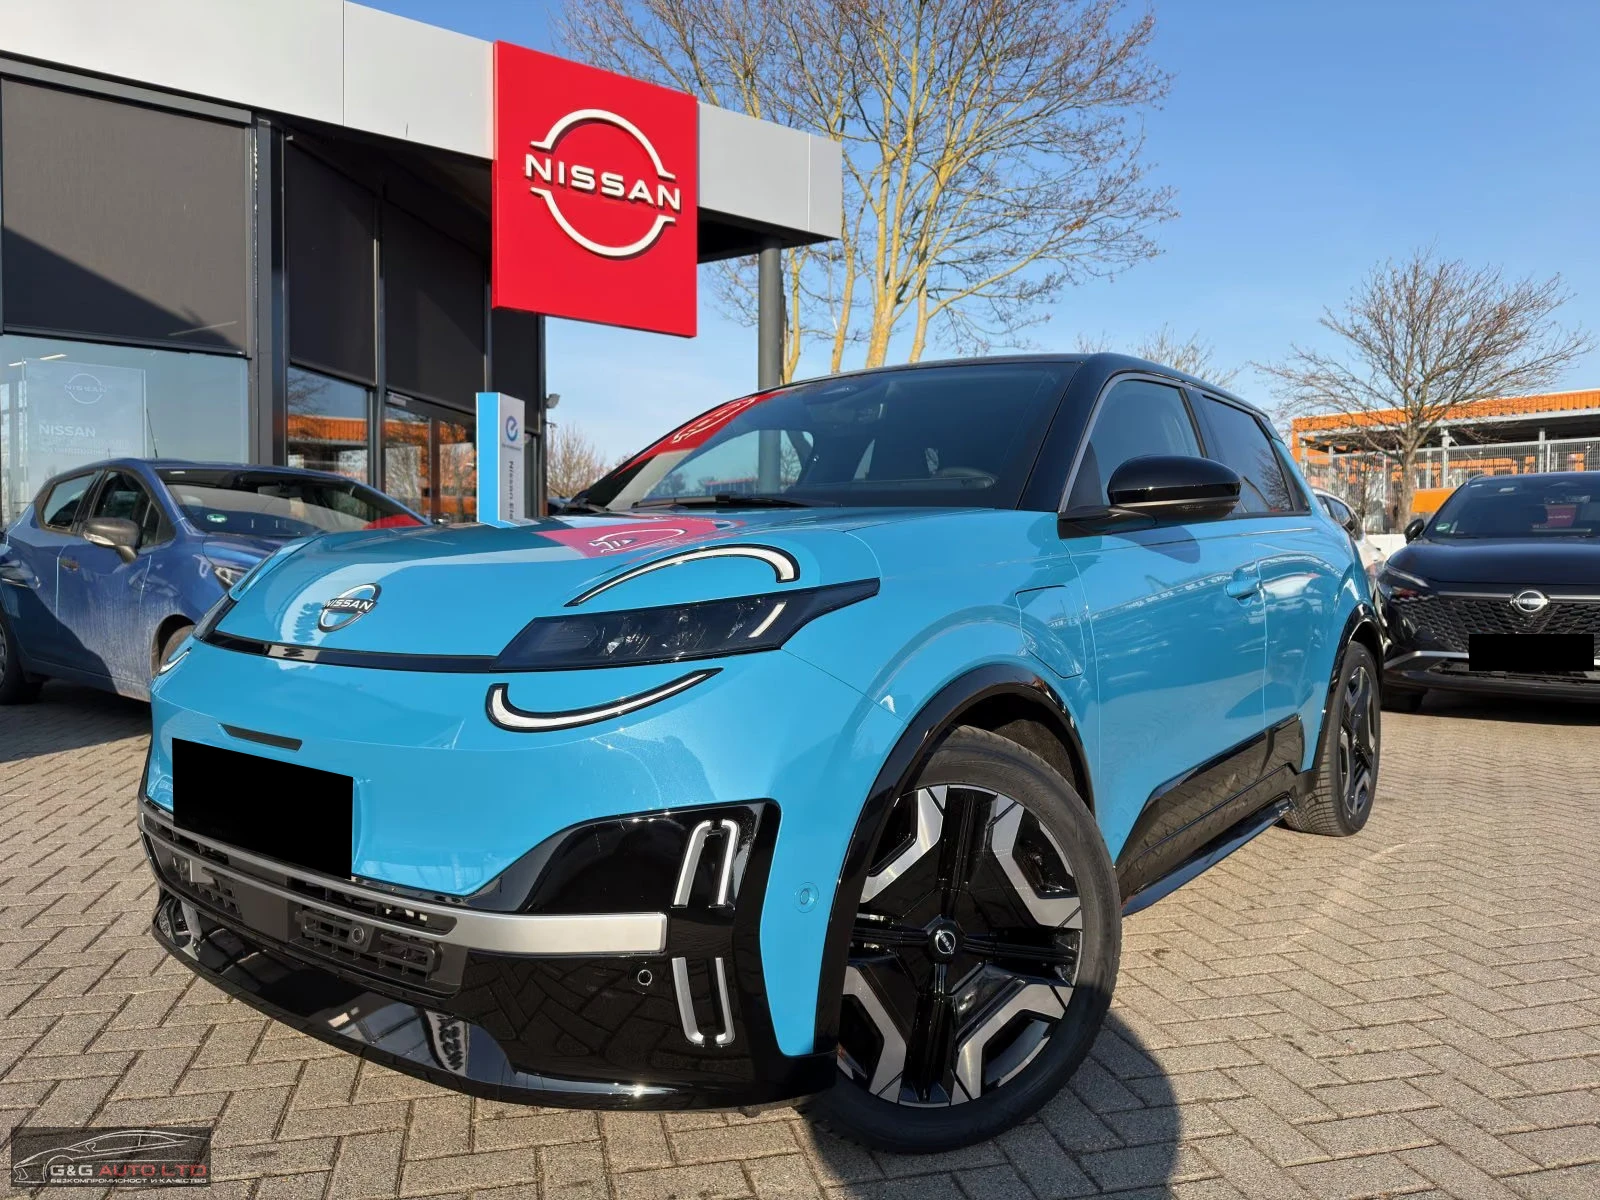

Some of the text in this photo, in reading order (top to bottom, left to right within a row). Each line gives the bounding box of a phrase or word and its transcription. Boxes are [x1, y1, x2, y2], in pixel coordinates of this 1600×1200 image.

[525, 153, 681, 211] NISSAN
[39, 423, 96, 438] NISSAN
[323, 599, 374, 611] NISSAN
